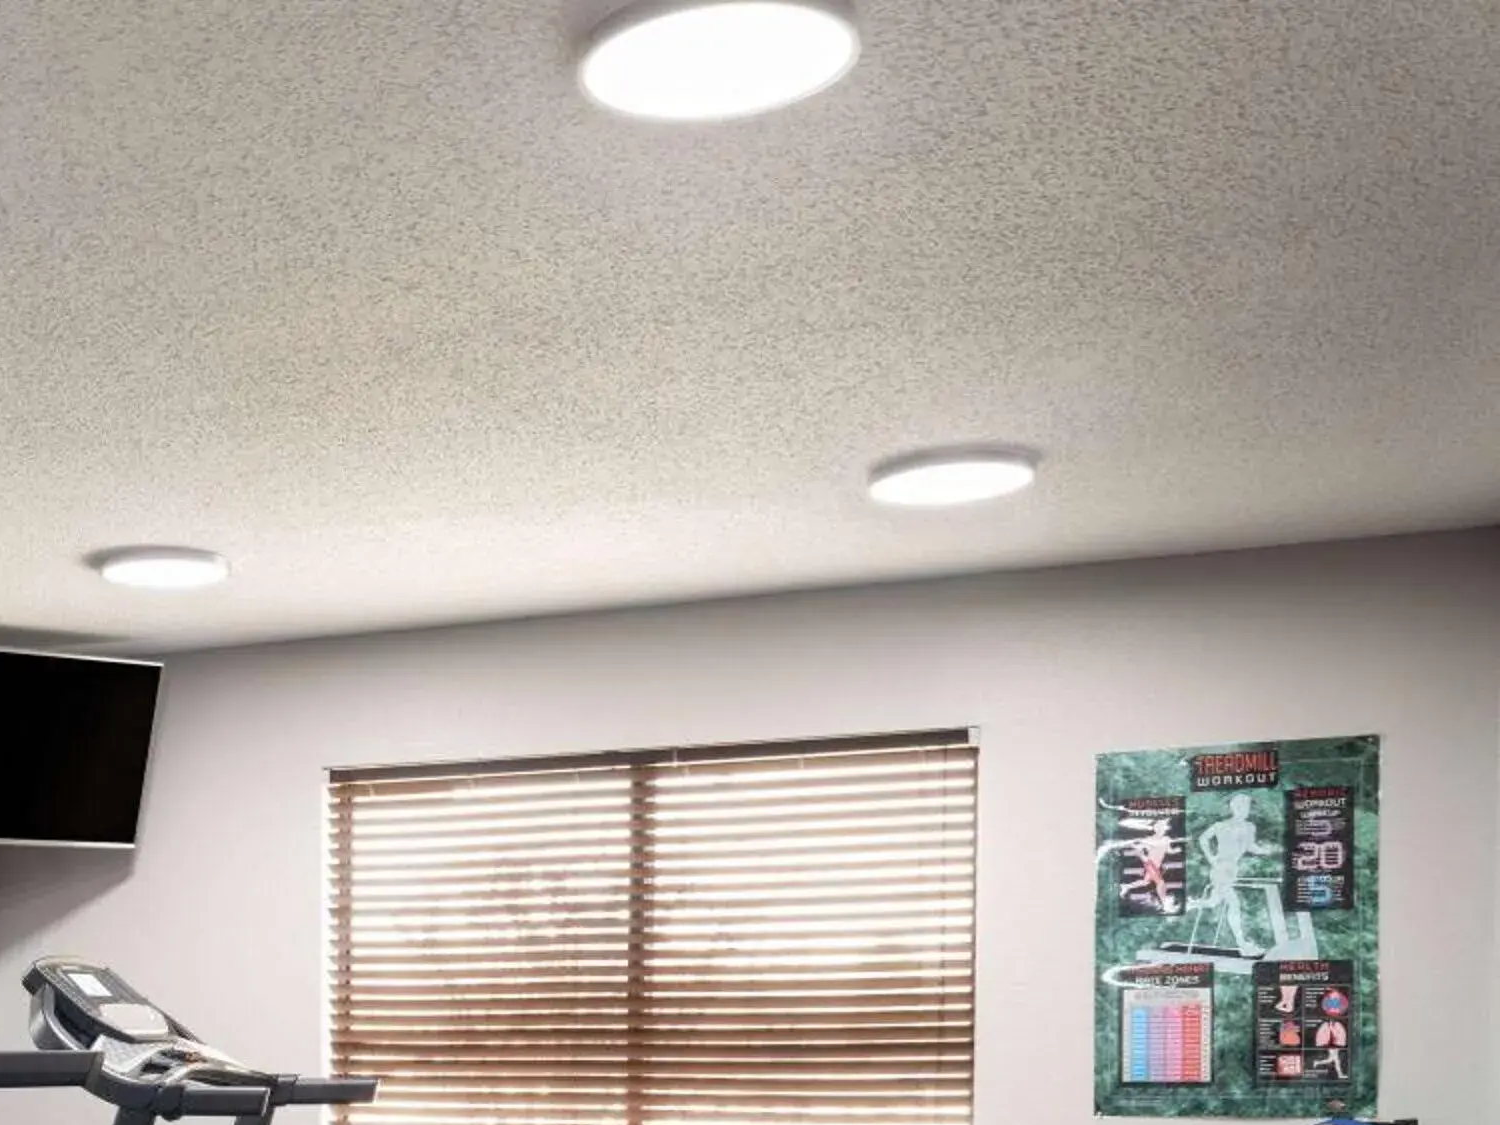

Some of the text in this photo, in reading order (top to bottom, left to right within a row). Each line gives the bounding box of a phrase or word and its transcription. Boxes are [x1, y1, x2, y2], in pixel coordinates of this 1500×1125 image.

[1194, 751, 1277, 775] TREADMILL
[1197, 771, 1277, 787] WORKOUT
[1296, 841, 1343, 871] 20
